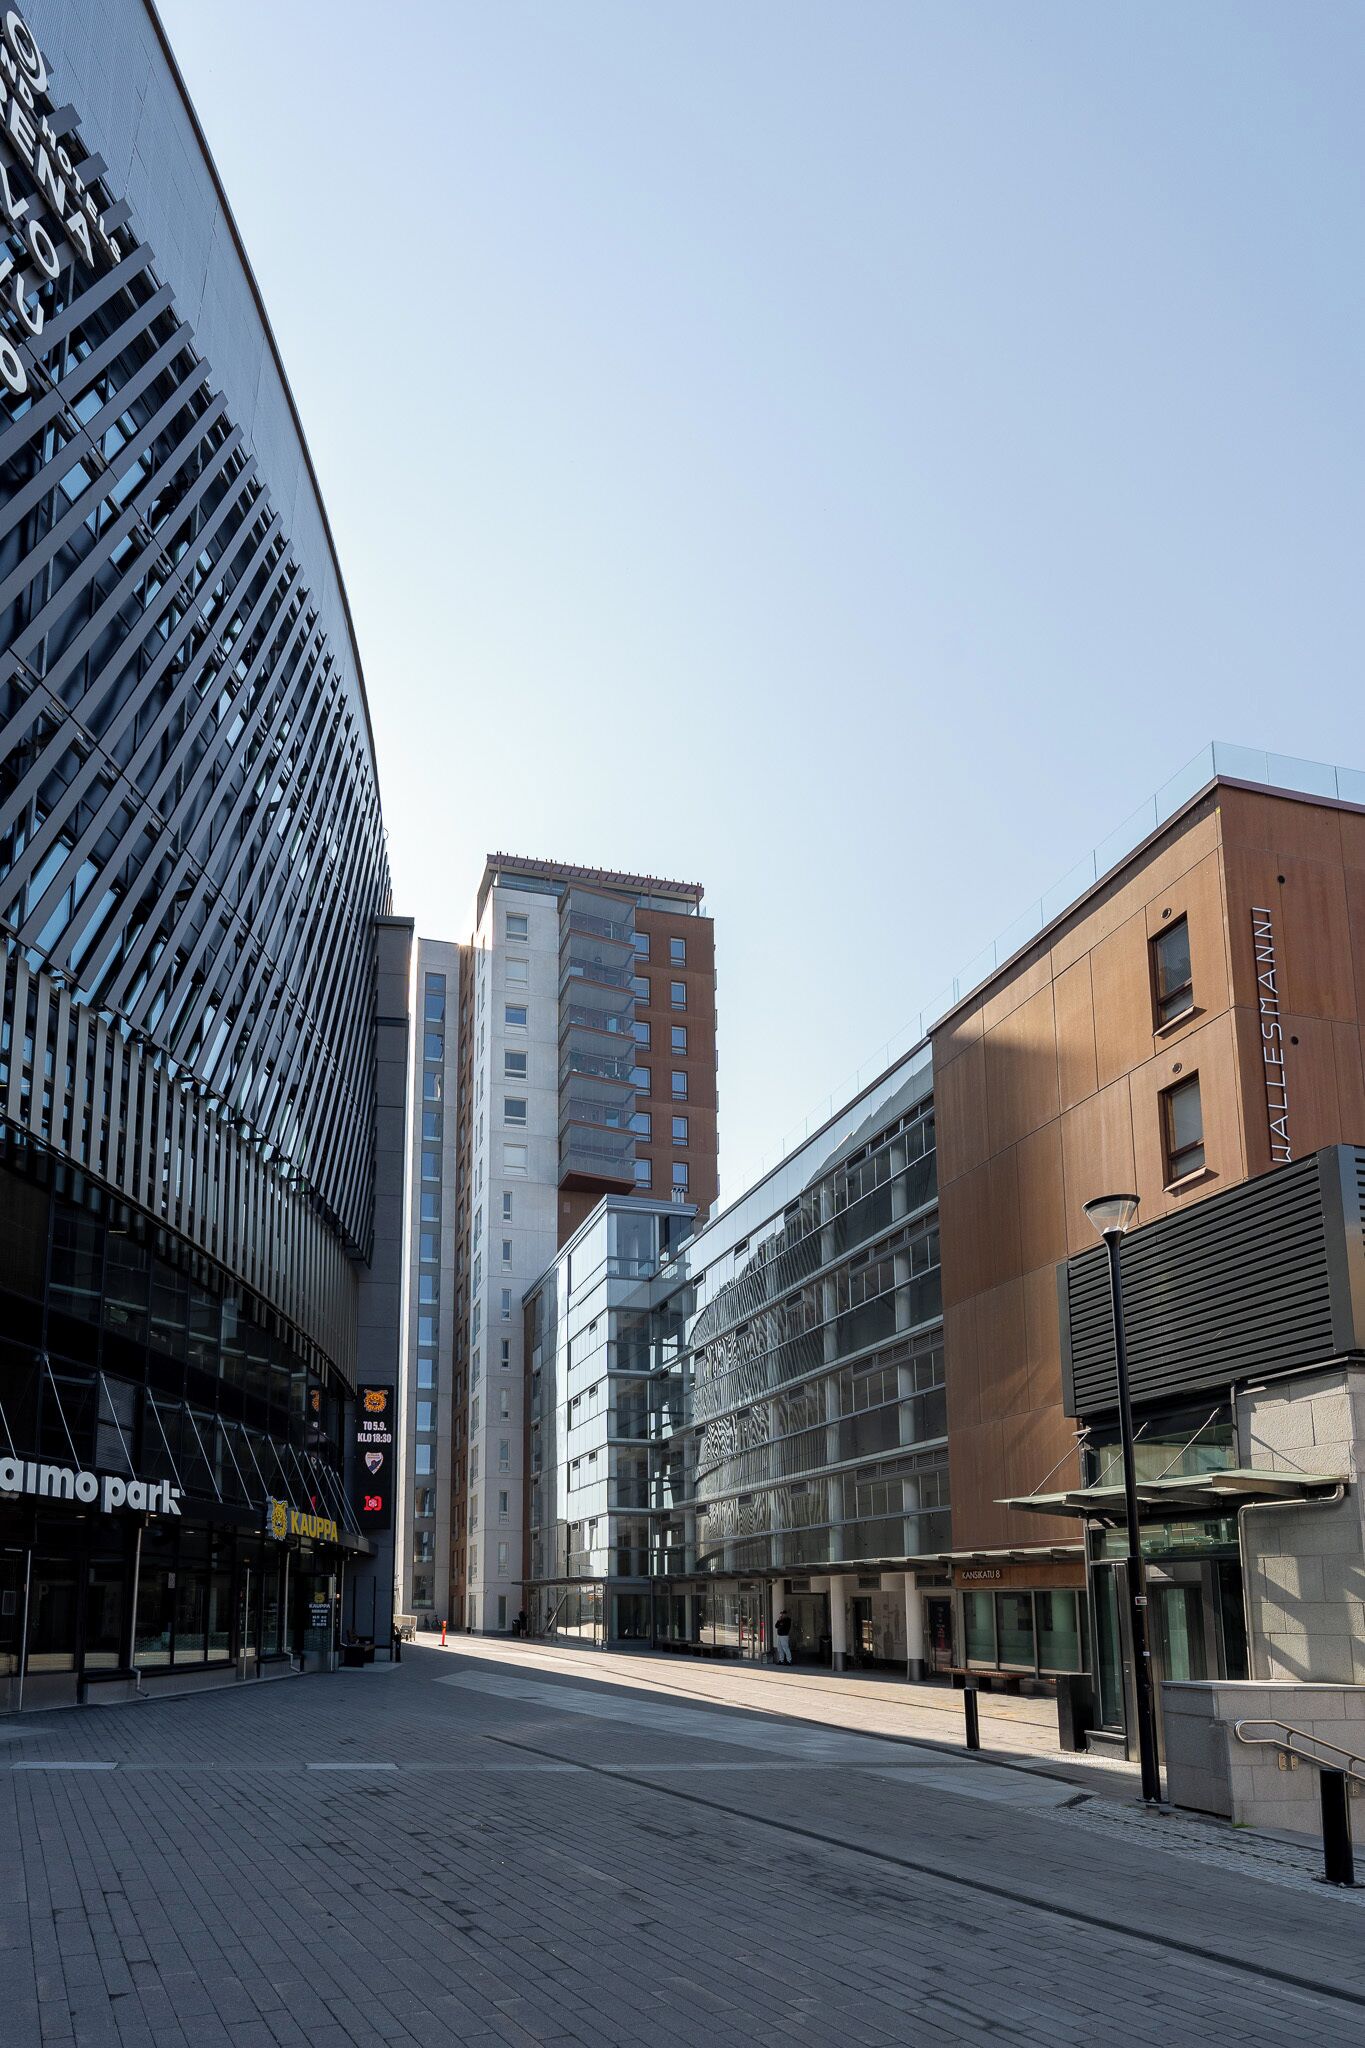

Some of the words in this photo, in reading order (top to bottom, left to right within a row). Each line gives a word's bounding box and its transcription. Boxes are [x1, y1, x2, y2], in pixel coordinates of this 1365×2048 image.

[42, 115, 121, 263] HOTELS
[1252, 906, 1292, 1164] WALLESMANNI
[357, 1432, 372, 1443] KLO
[373, 1433, 392, 1443] 18:30
[363, 1421, 373, 1431] TO
[373, 1421, 387, 1431] 5.9.
[0, 1457, 99, 1503] aimo
[102, 1475, 182, 1515] park
[291, 1510, 338, 1543] KAUPPA
[961, 1569, 995, 1579] KANSIKATU
[995, 1569, 1001, 1579] 8
